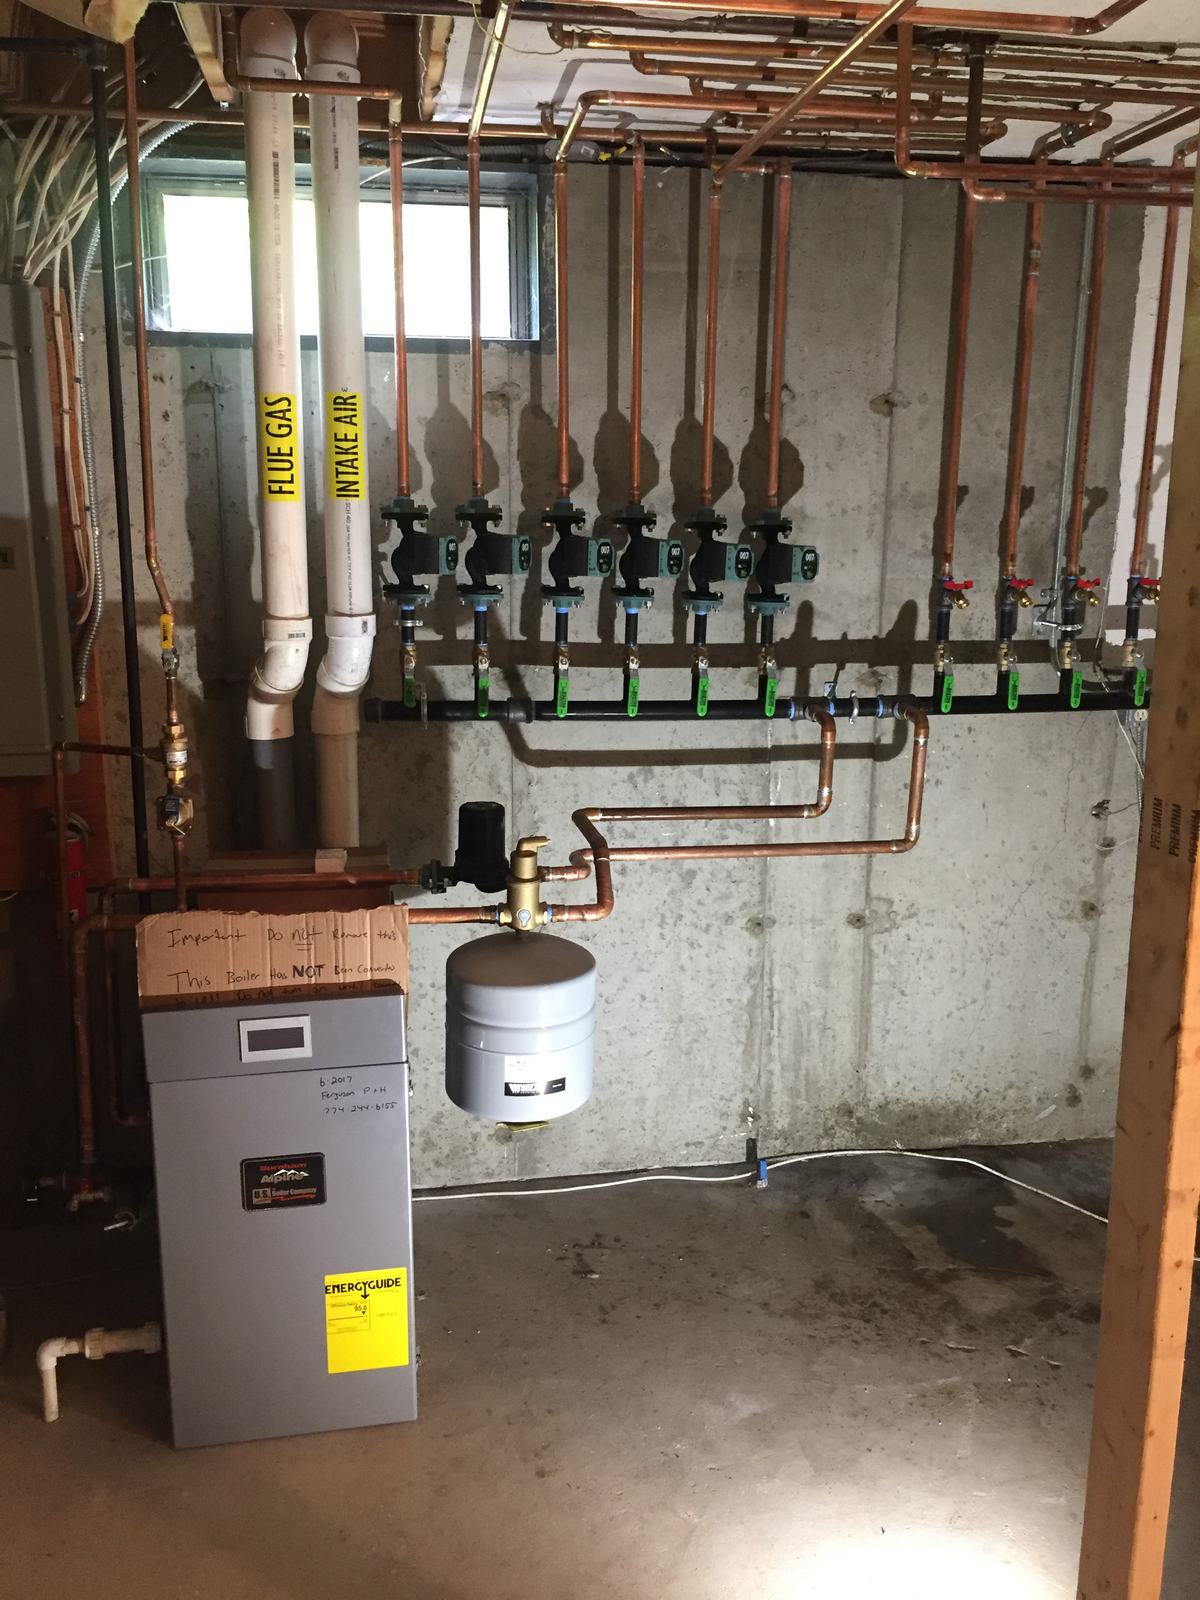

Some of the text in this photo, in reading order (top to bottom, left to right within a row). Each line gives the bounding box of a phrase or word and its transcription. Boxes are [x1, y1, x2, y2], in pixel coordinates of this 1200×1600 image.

[264, 396, 292, 438] GAS
[332, 394, 360, 498] INTAKE AIR
[266, 446, 294, 494] FLUE
[600, 545, 610, 554] 007
[739, 551, 749, 560] 007
[805, 553, 815, 561] 007
[1150, 797, 1163, 850] PREMIUM
[167, 928, 246, 948] Important
[167, 969, 211, 992] This
[226, 970, 260, 985] Boiler
[270, 967, 288, 980] Has
[292, 963, 325, 979] NOT
[320, 1090, 356, 1101] Ferguson
[363, 1086, 371, 1095] P
[260, 1173, 305, 1184] Alpine
